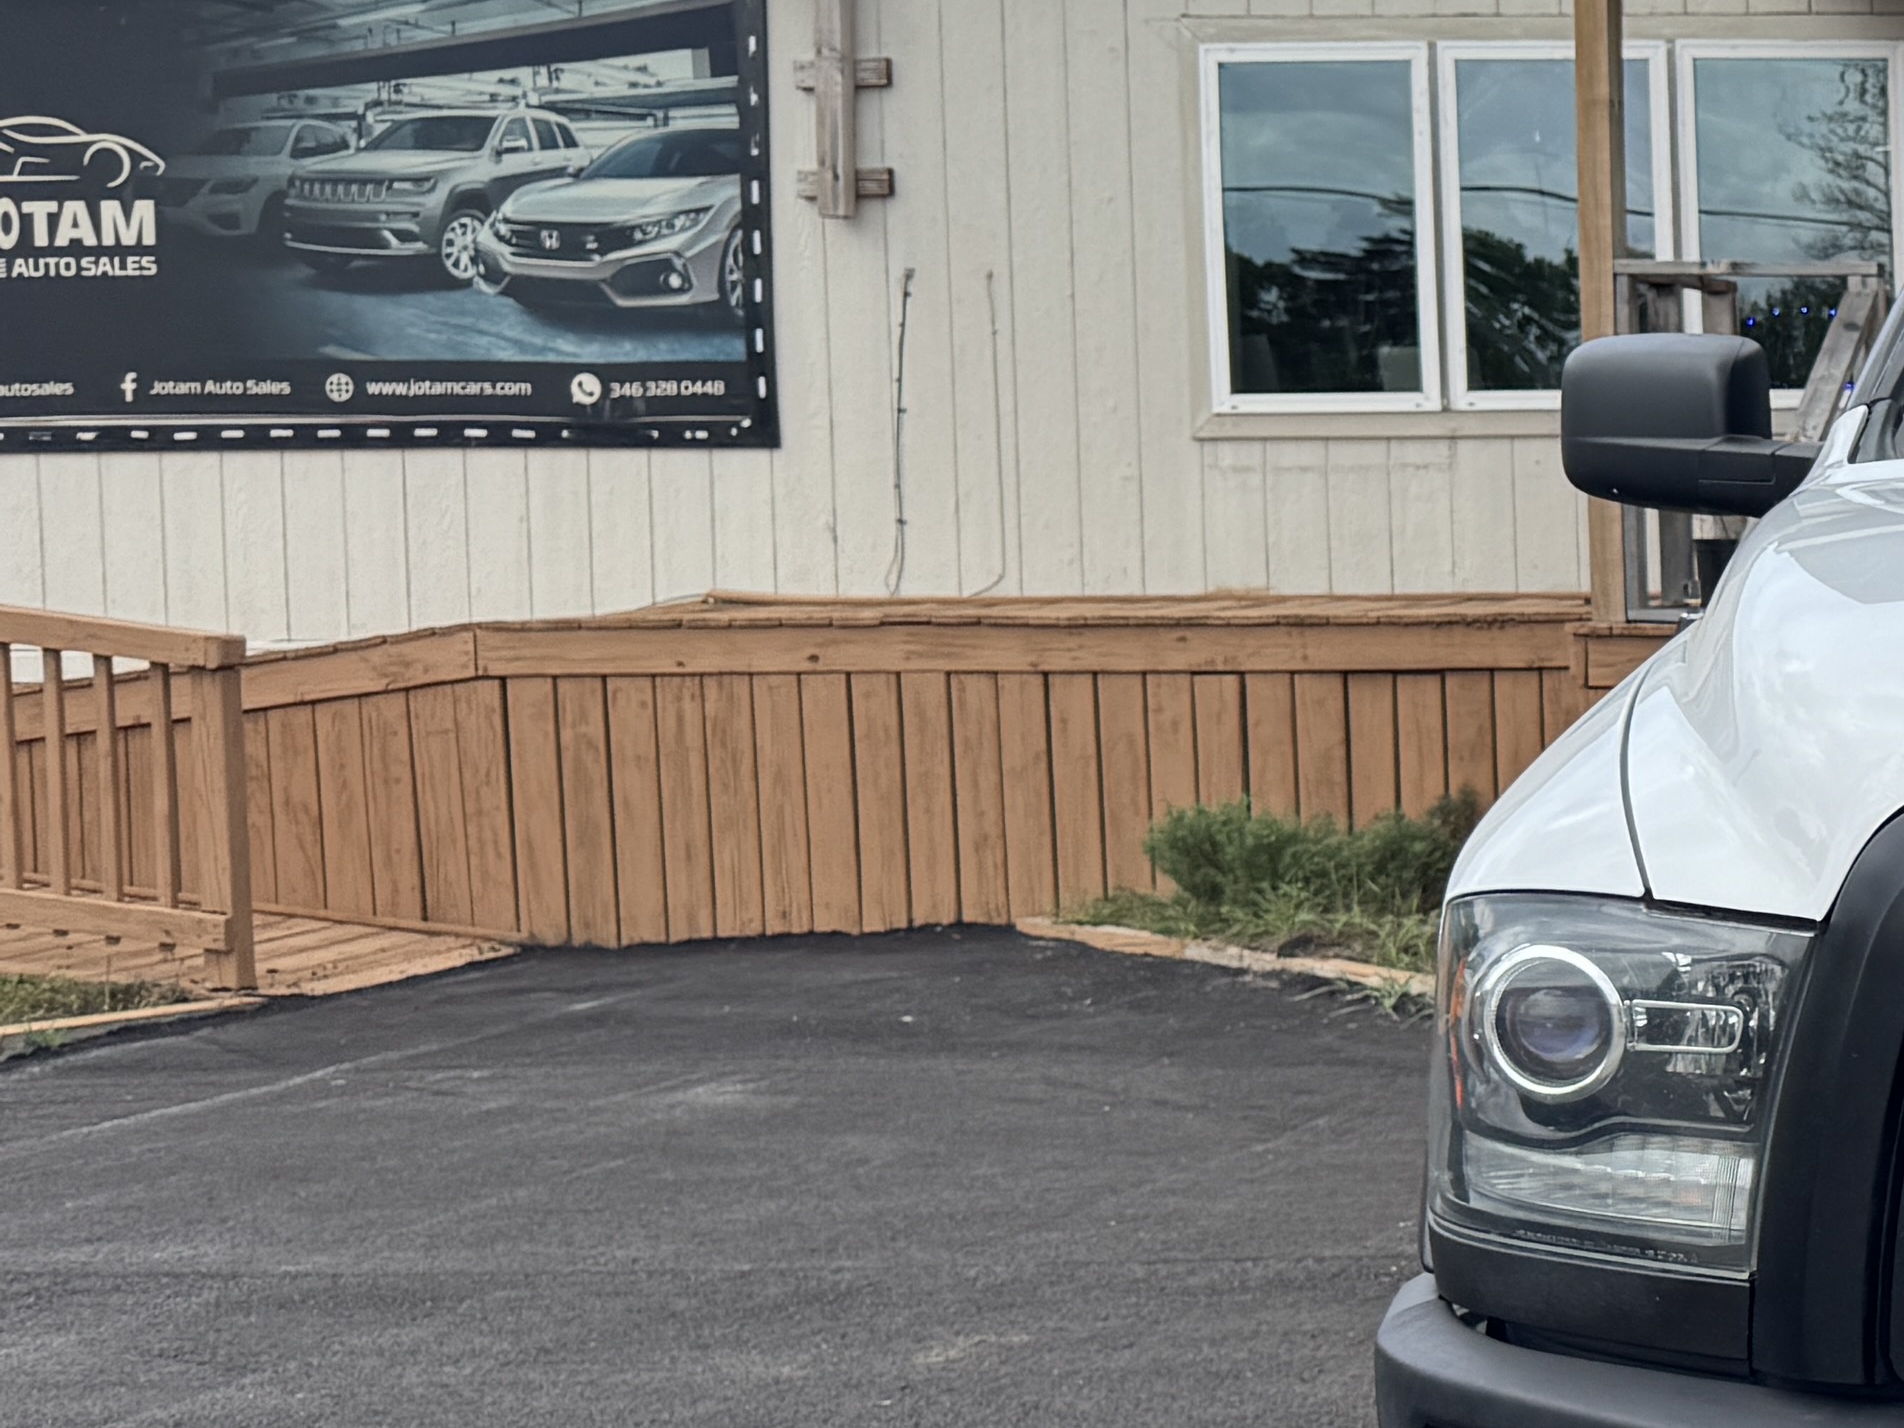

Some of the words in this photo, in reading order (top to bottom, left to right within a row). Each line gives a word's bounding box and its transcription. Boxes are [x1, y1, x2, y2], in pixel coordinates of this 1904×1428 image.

[11, 257, 77, 278] AUTO
[80, 255, 158, 277] SALES
[149, 380, 201, 396] Jotam
[203, 379, 244, 395] Auto
[246, 379, 291, 395] Sales
[366, 378, 532, 397] www.jotamcars.com
